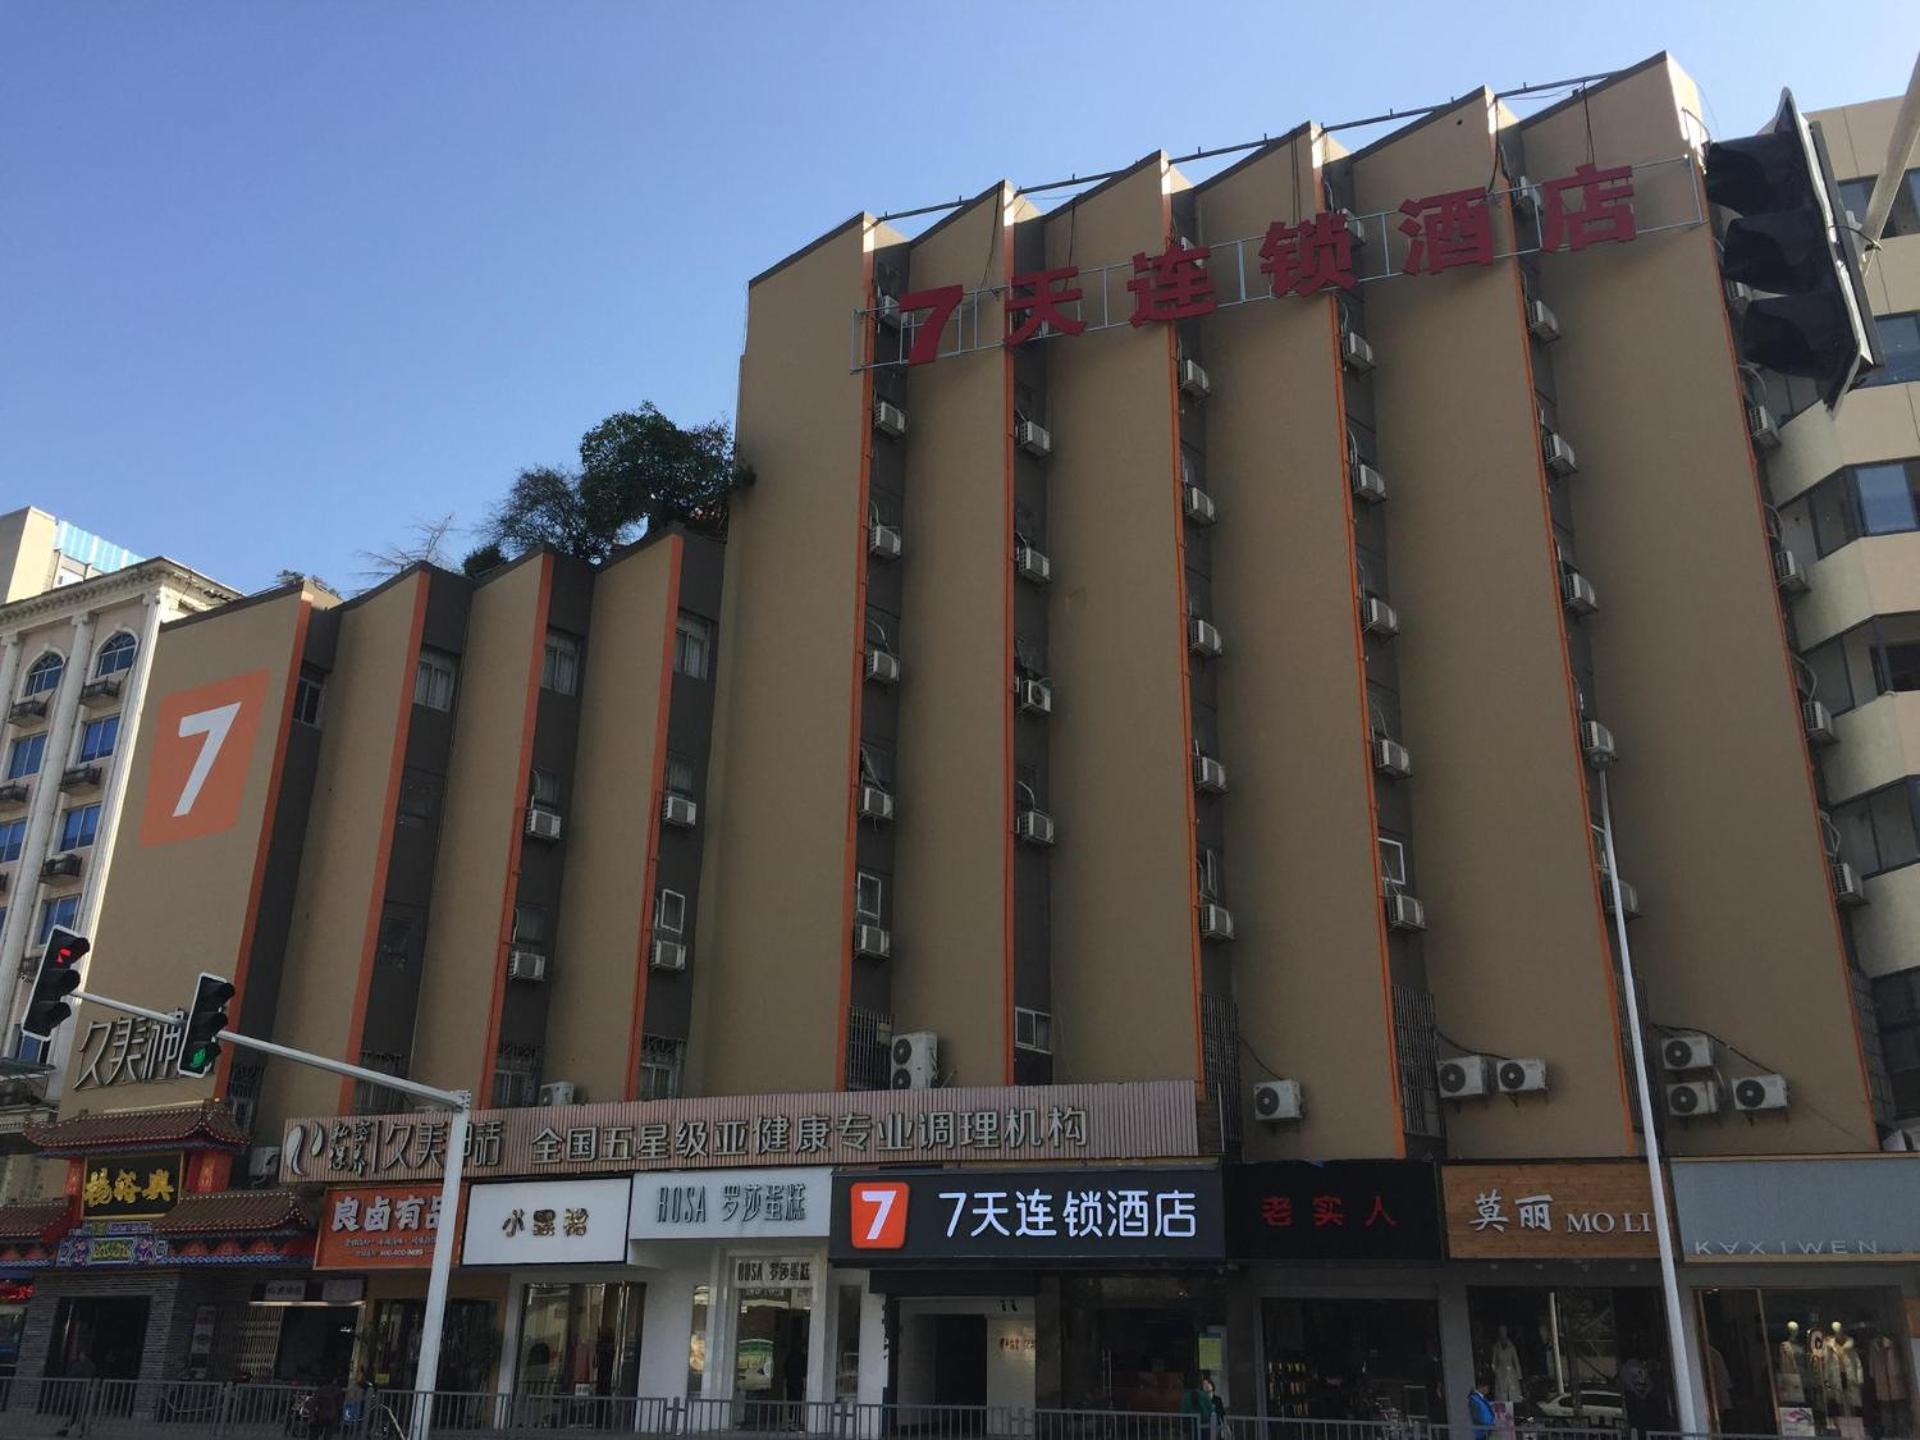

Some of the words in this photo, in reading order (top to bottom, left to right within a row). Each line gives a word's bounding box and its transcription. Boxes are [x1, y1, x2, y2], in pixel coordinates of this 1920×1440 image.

[899, 164, 1637, 366] 7天连锁酒店
[172, 702, 242, 817] 7
[532, 1107, 1088, 1165] 全国五星级亚健康专业调理机构
[657, 1185, 706, 1223] ROSA
[722, 1183, 806, 1222] 罗莎蛋糕
[862, 1190, 897, 1239] 7
[938, 1189, 1196, 1238] 7天连锁酒店
[1261, 1196, 1397, 1227] 老实人
[1469, 1190, 1553, 1233] 莫丽
[1566, 1212, 1615, 1234] MO
[1625, 1212, 1652, 1233] LI
